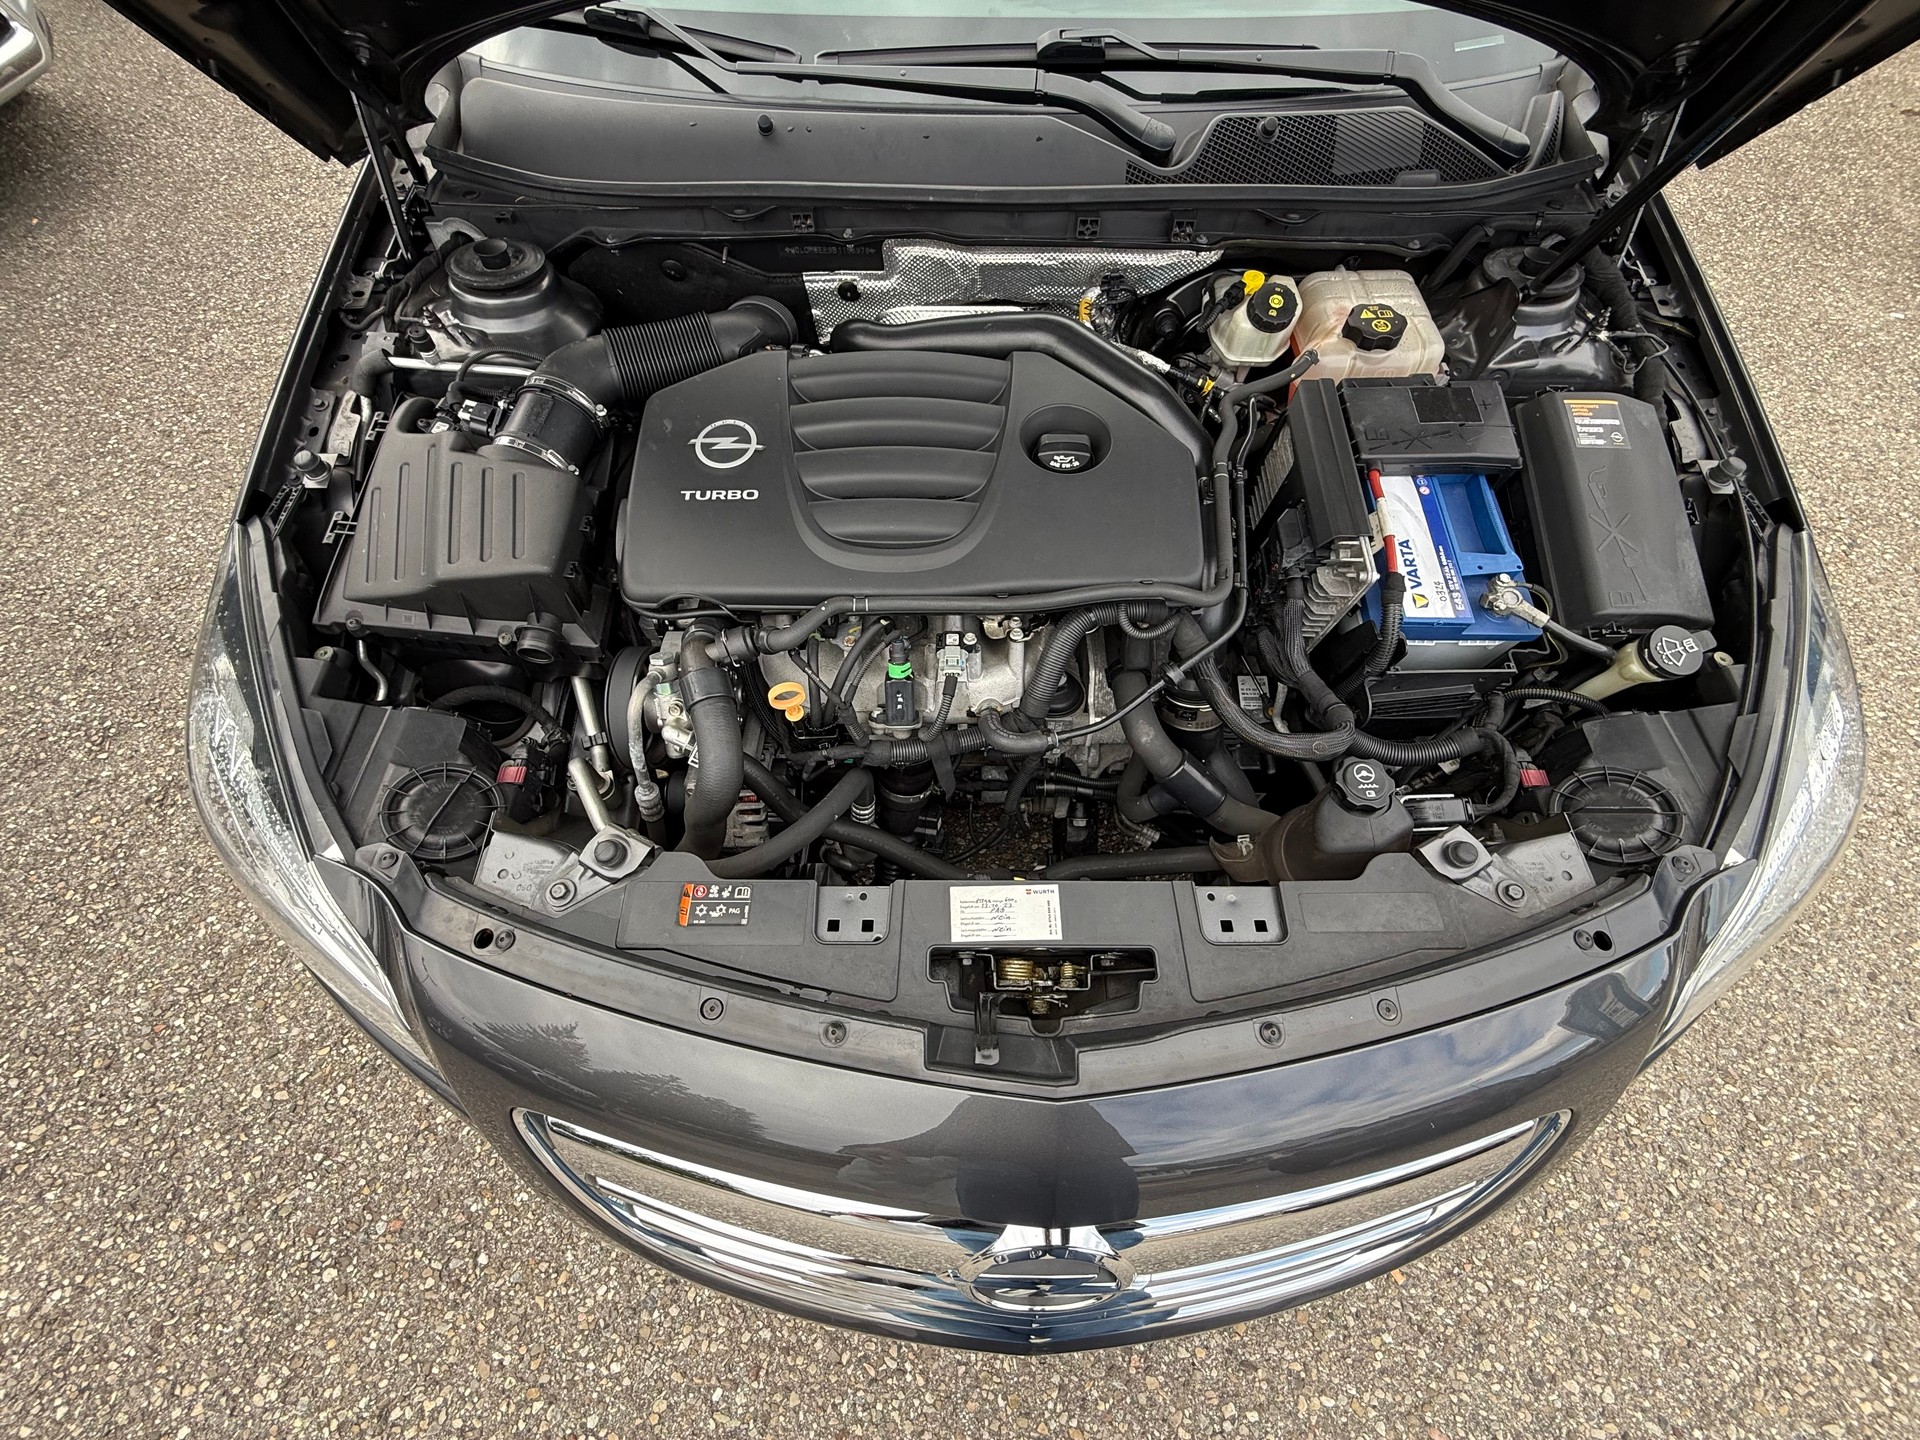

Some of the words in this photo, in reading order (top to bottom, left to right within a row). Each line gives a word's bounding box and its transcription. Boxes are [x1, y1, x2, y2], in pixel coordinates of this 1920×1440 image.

[680, 489, 759, 500] TURBO
[1398, 539, 1422, 590] VARTA
[1451, 592, 1465, 611] E43
